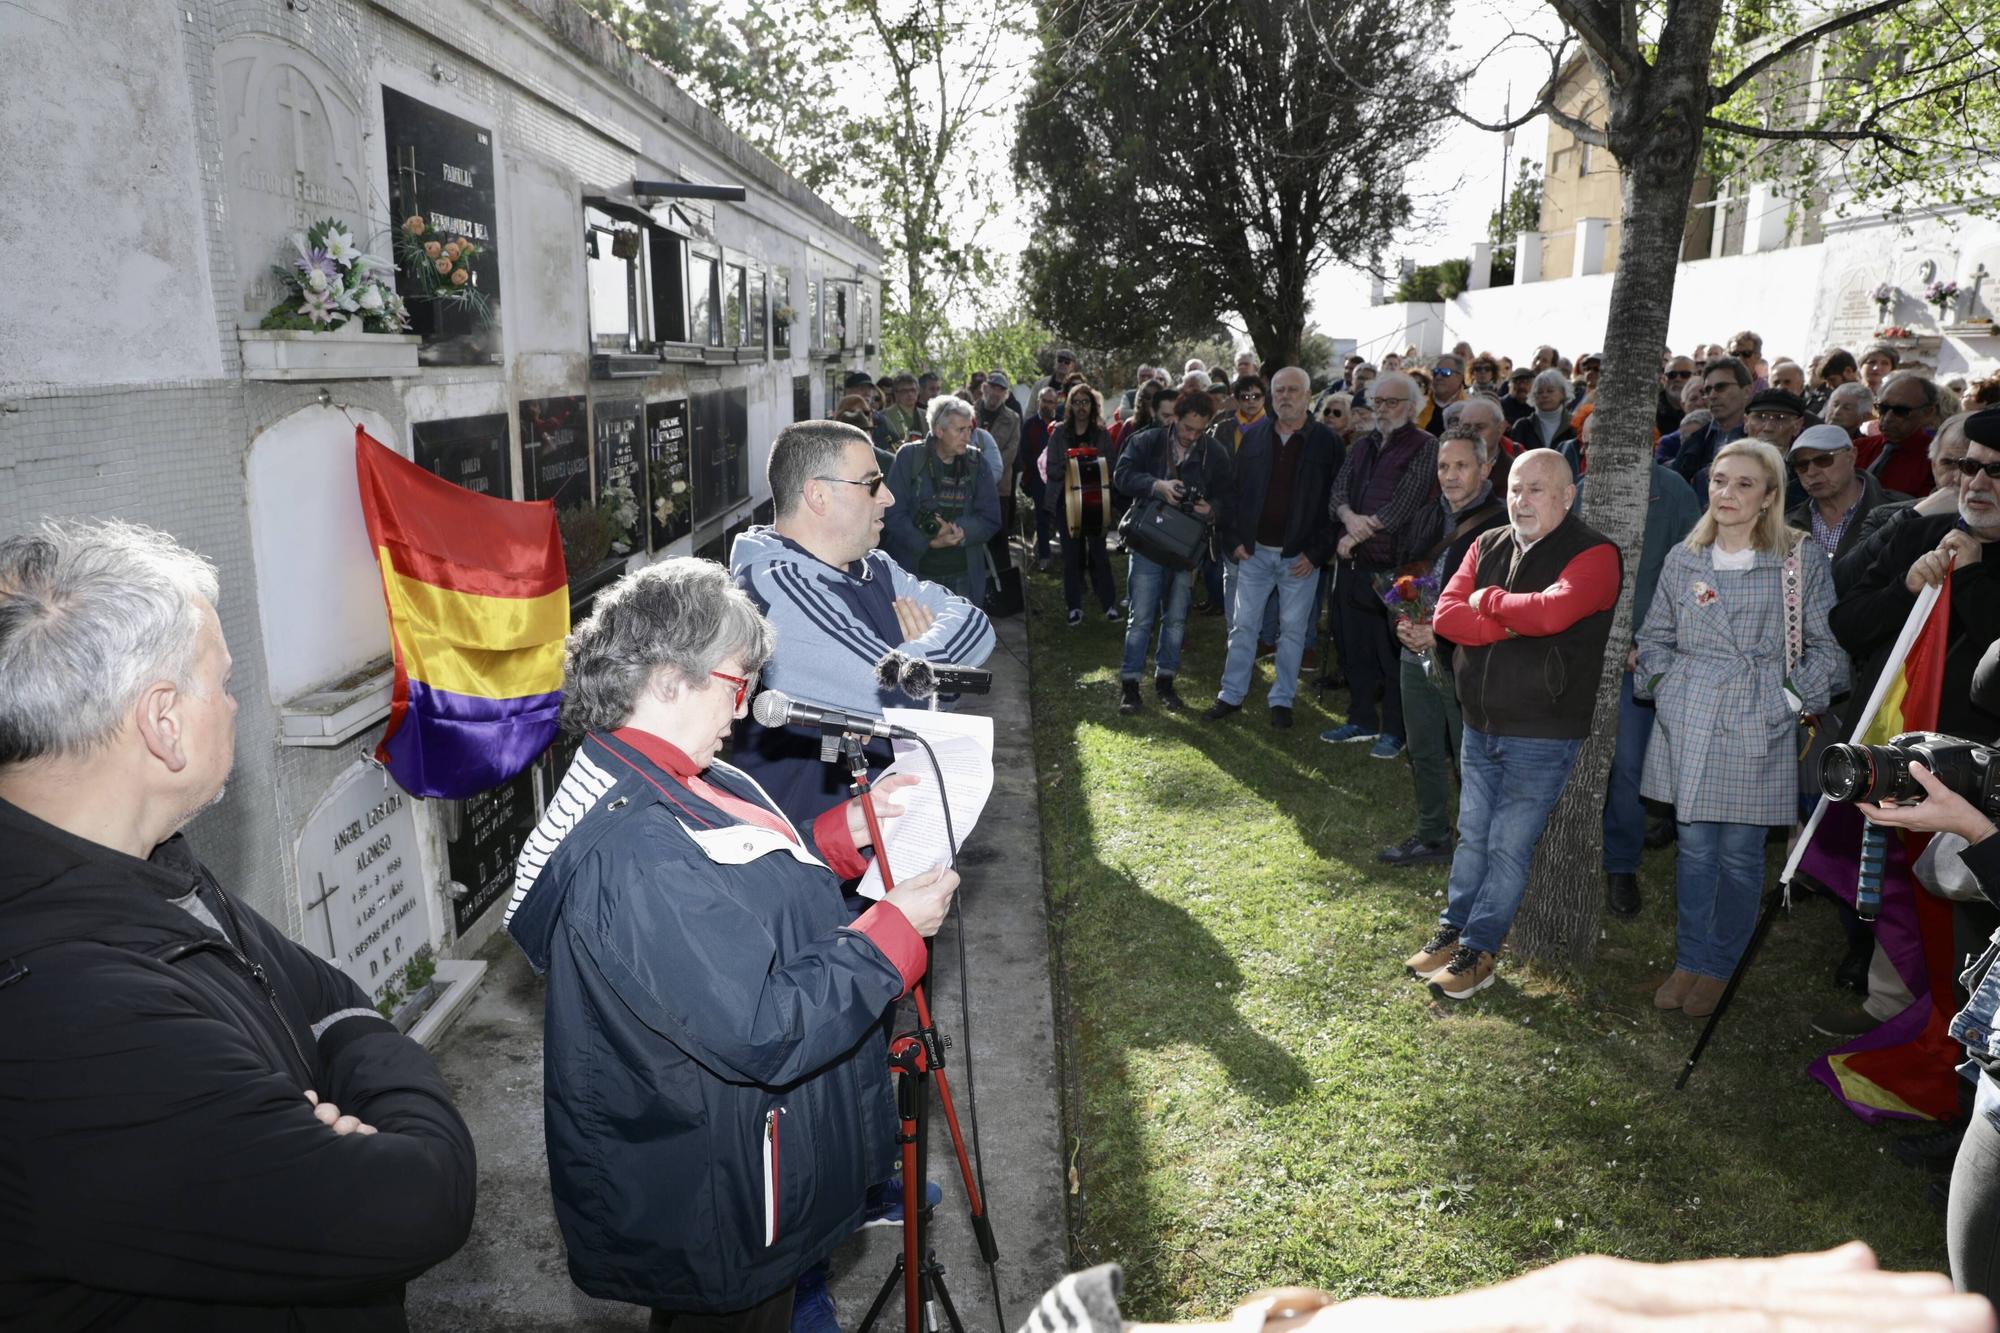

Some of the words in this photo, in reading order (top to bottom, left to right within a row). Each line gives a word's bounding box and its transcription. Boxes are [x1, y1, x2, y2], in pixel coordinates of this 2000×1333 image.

[442, 163, 474, 189] FAMILIA
[332, 819, 365, 855] ANGEL
[366, 793, 403, 829] LOSADA
[355, 833, 392, 874] ALONSO
[363, 903, 377, 922] LOS
